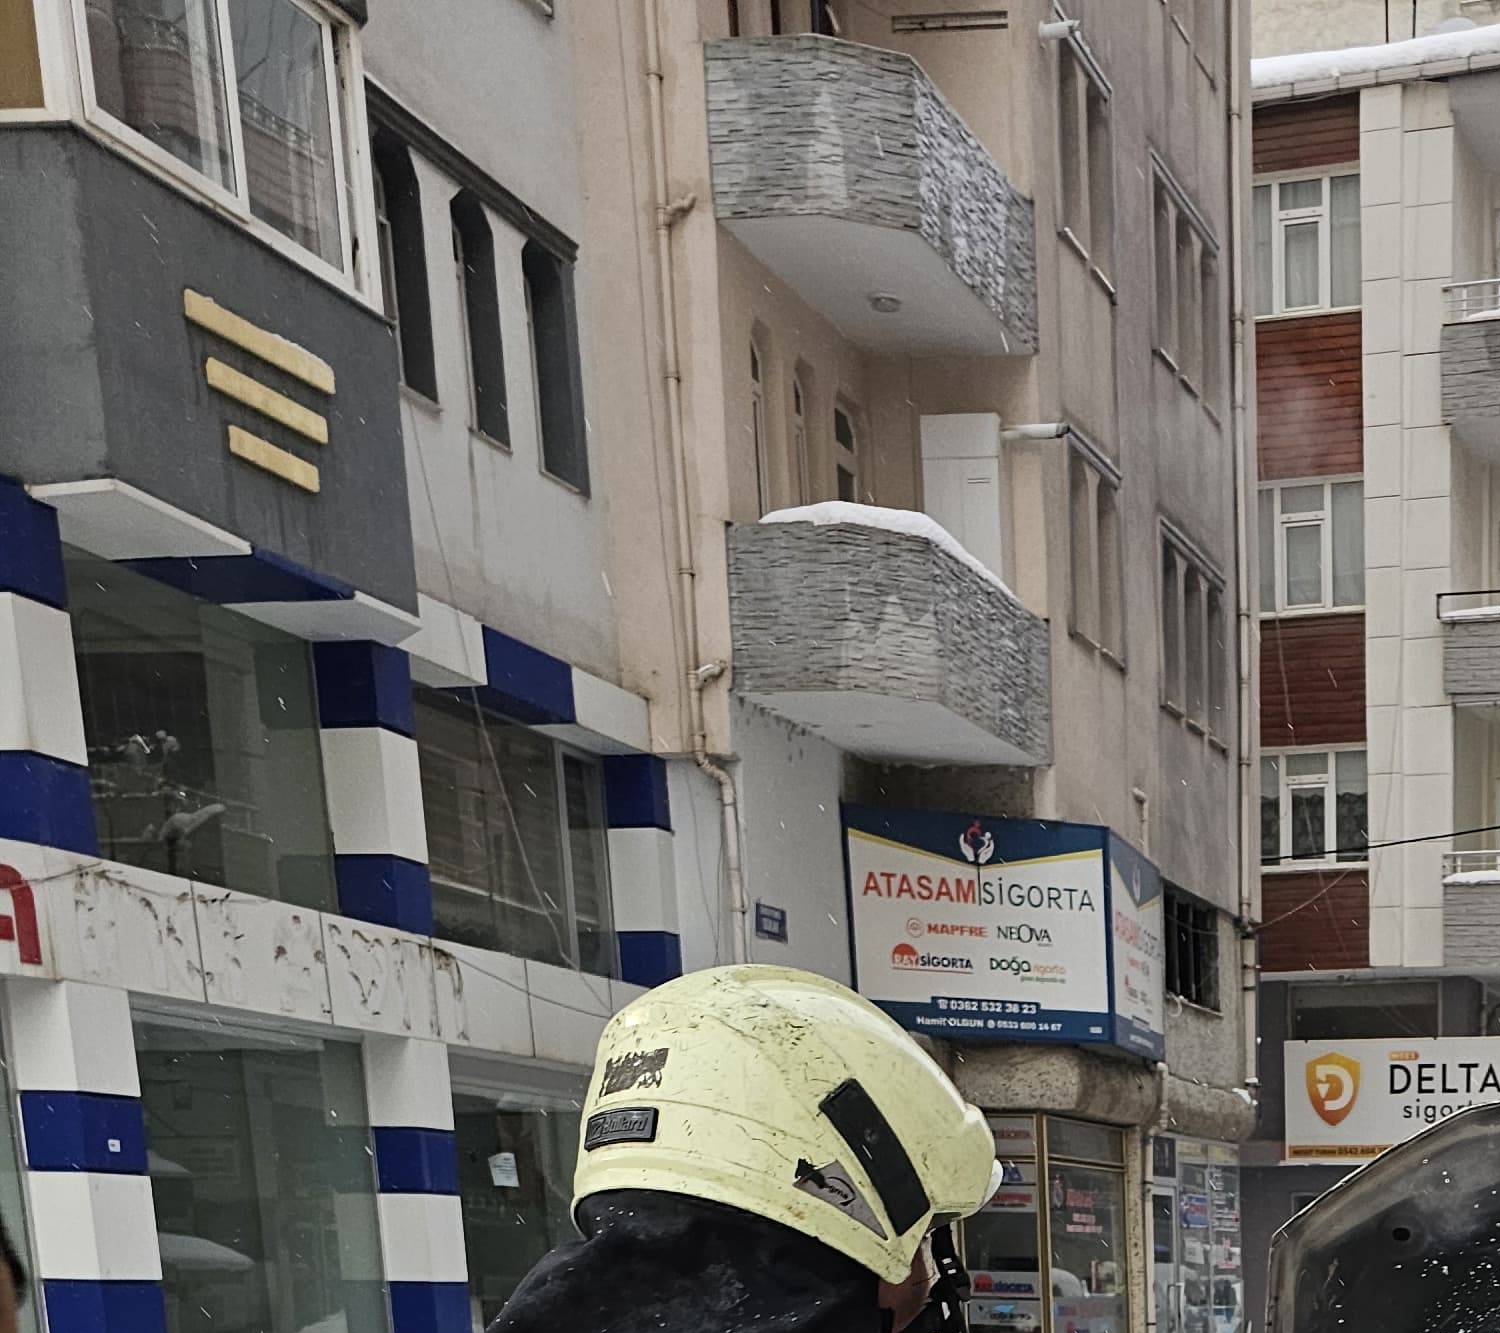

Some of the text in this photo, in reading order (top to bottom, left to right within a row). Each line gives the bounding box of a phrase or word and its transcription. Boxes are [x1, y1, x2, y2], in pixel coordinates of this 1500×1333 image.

[862, 869, 1096, 913] ATASAM SİGORTA
[927, 923, 988, 938] MAPFRE
[997, 924, 1052, 943] NEOVA
